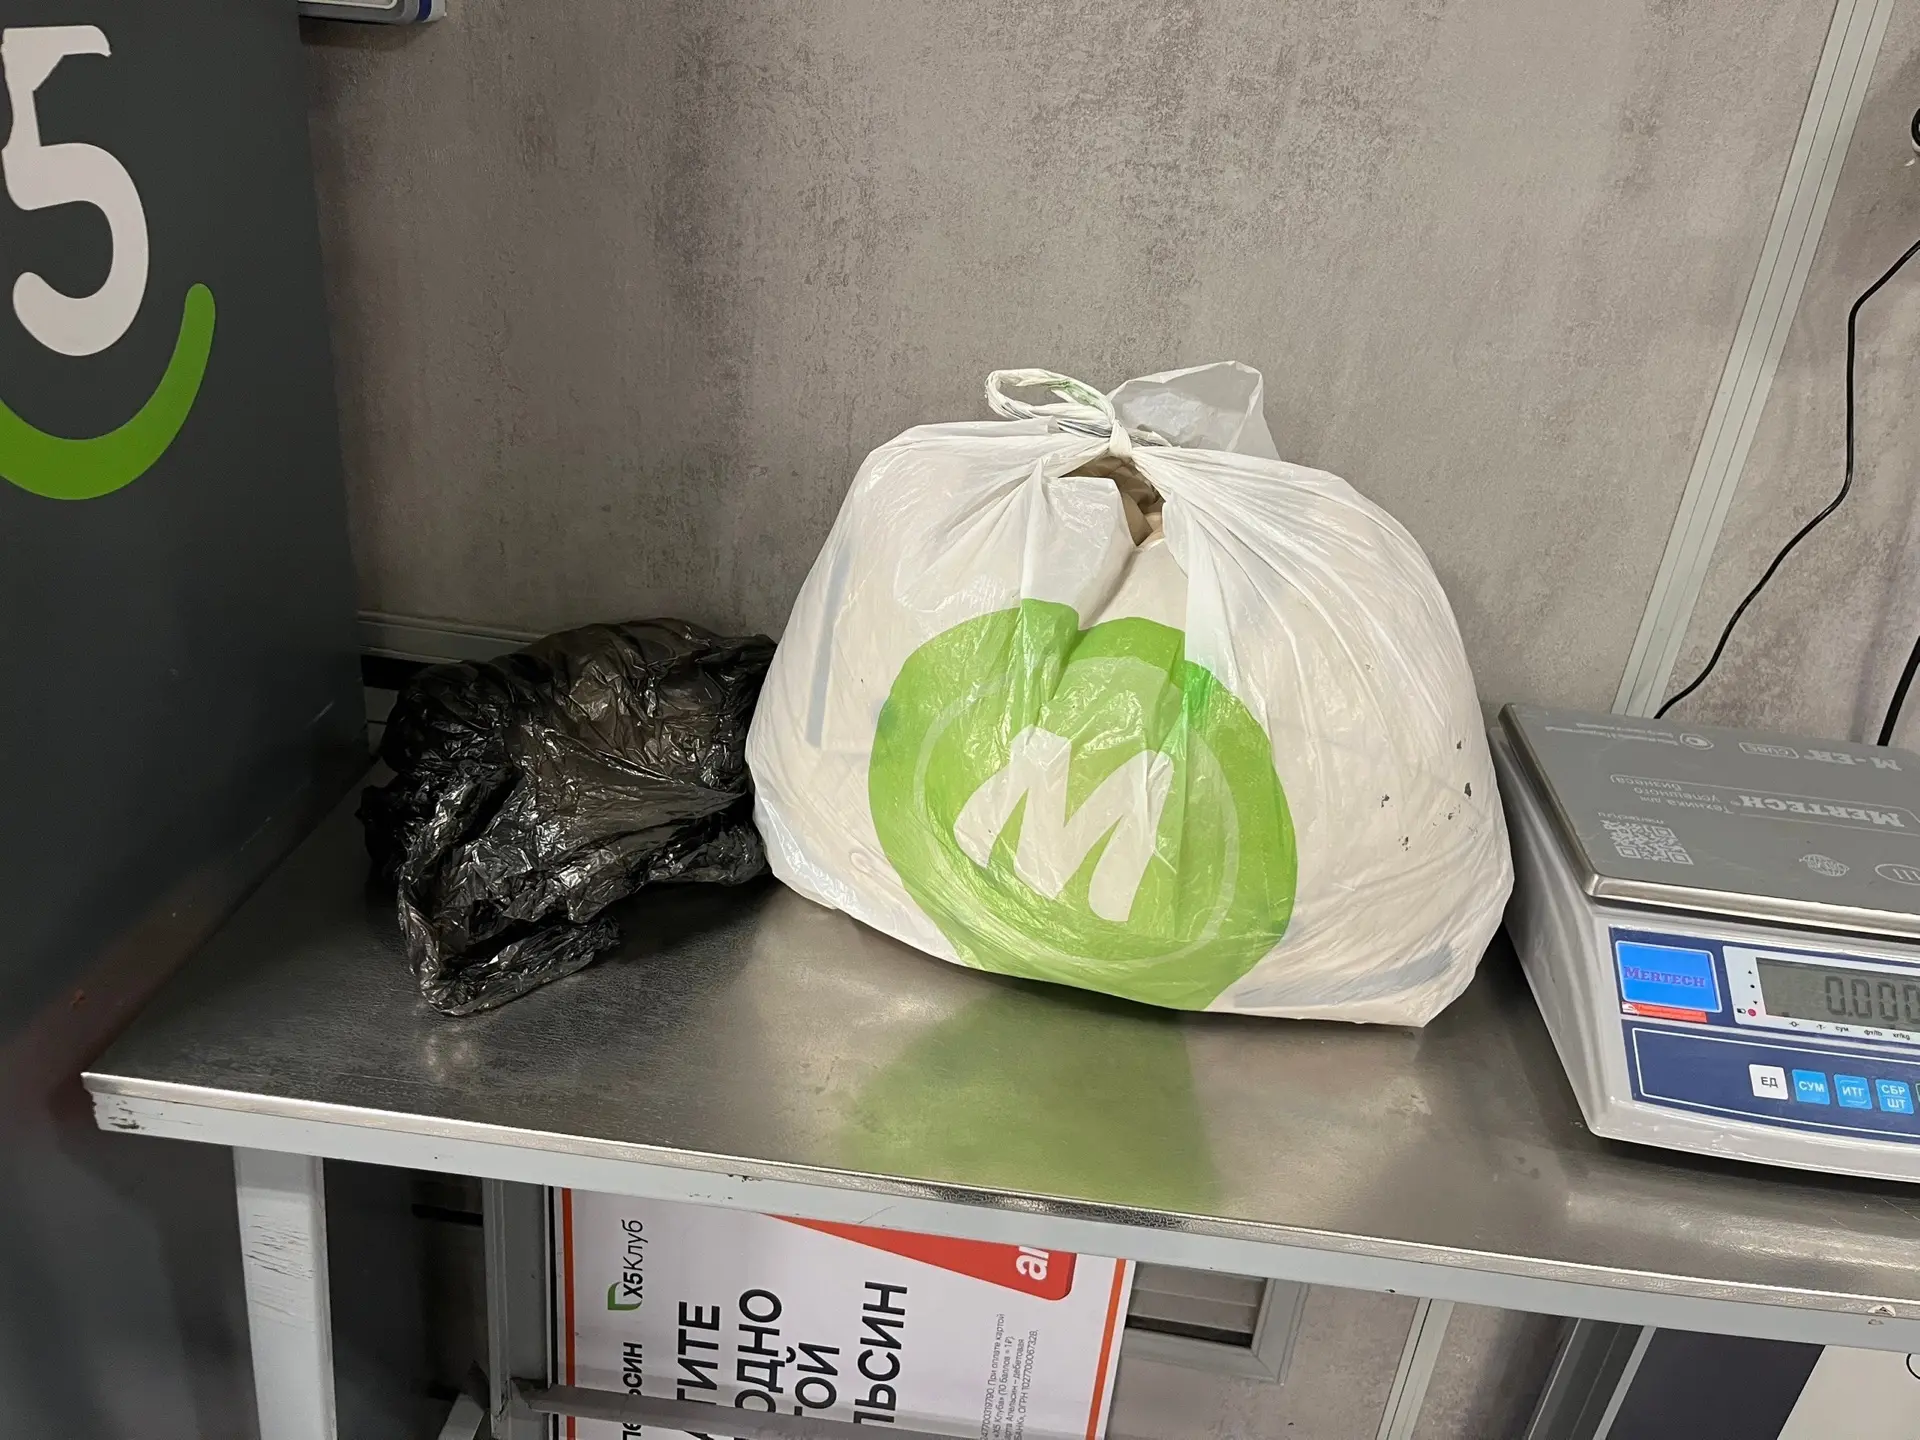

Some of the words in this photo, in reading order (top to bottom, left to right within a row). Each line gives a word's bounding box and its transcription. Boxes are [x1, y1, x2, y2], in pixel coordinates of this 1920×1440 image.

[1, 25, 149, 357] 5
[1738, 794, 1905, 828] MERTECH
[1623, 966, 1705, 988] MERTECH
[1760, 1076, 1779, 1089] ЕД
[1798, 1080, 1825, 1093] СУМ
[1881, 1084, 1906, 1096] СБР
[1842, 1086, 1865, 1097] ИТГ
[1887, 1098, 1907, 1110] ШТ
[734, 1289, 785, 1413] ОДНО
[786, 1342, 840, 1416] ОЙ
